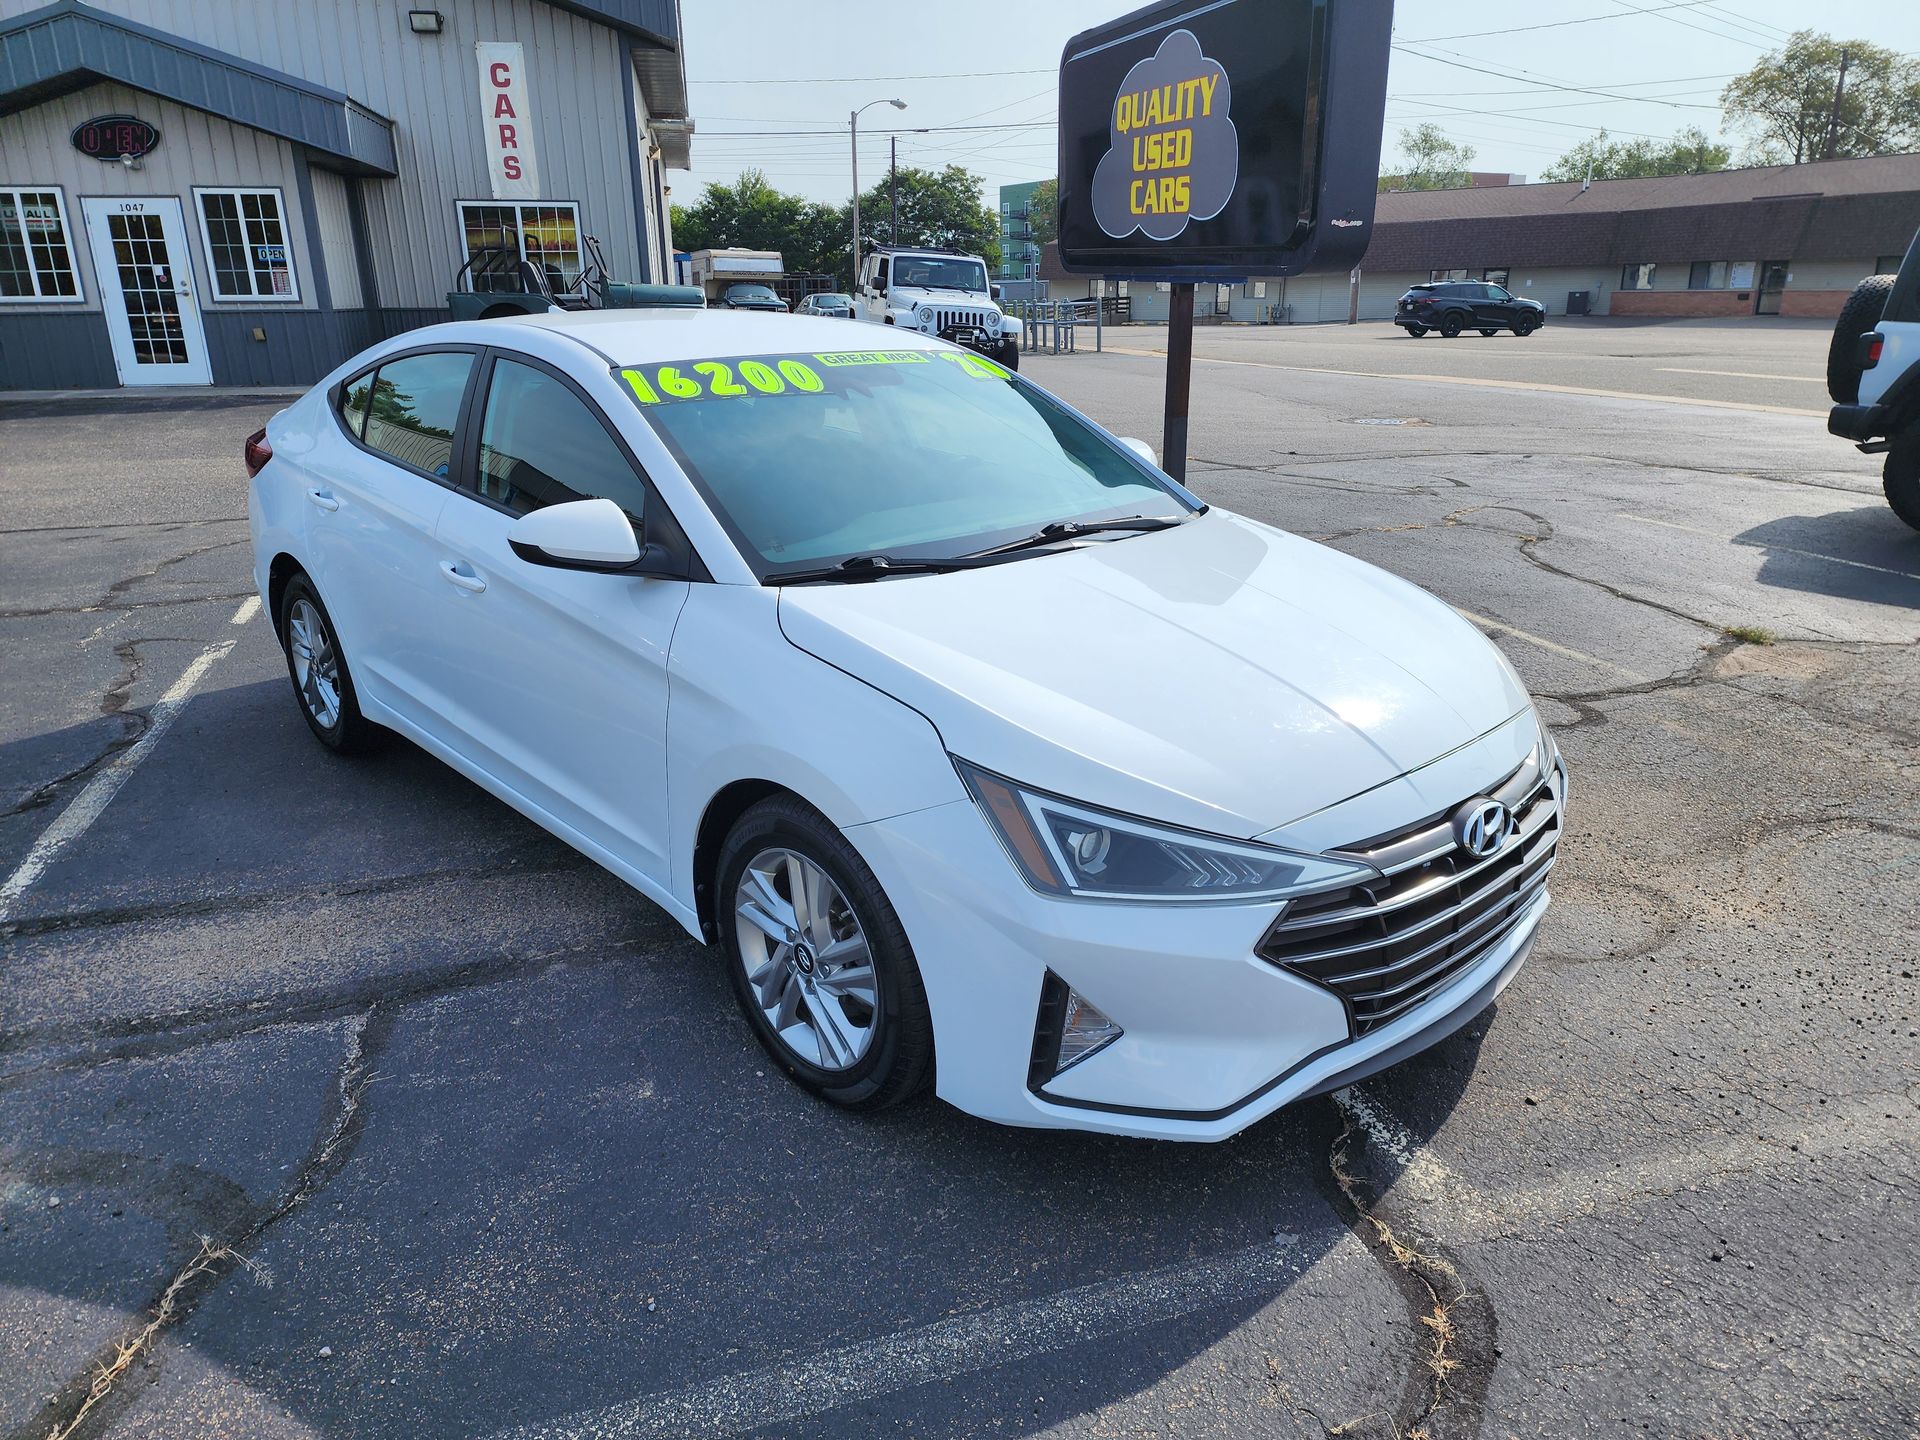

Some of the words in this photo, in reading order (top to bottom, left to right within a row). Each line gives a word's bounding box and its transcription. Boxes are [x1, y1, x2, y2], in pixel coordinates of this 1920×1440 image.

[490, 62, 522, 180] CARS
[1116, 73, 1219, 134] QUALITY
[1132, 128, 1192, 172] USED
[3, 210, 51, 218] U-AUL
[119, 203, 144, 212] 1047
[1130, 175, 1191, 214] CARS
[260, 249, 285, 259] OPEN
[823, 353, 880, 365] GREAT
[882, 352, 920, 362] MPG
[621, 360, 824, 404] 16200
